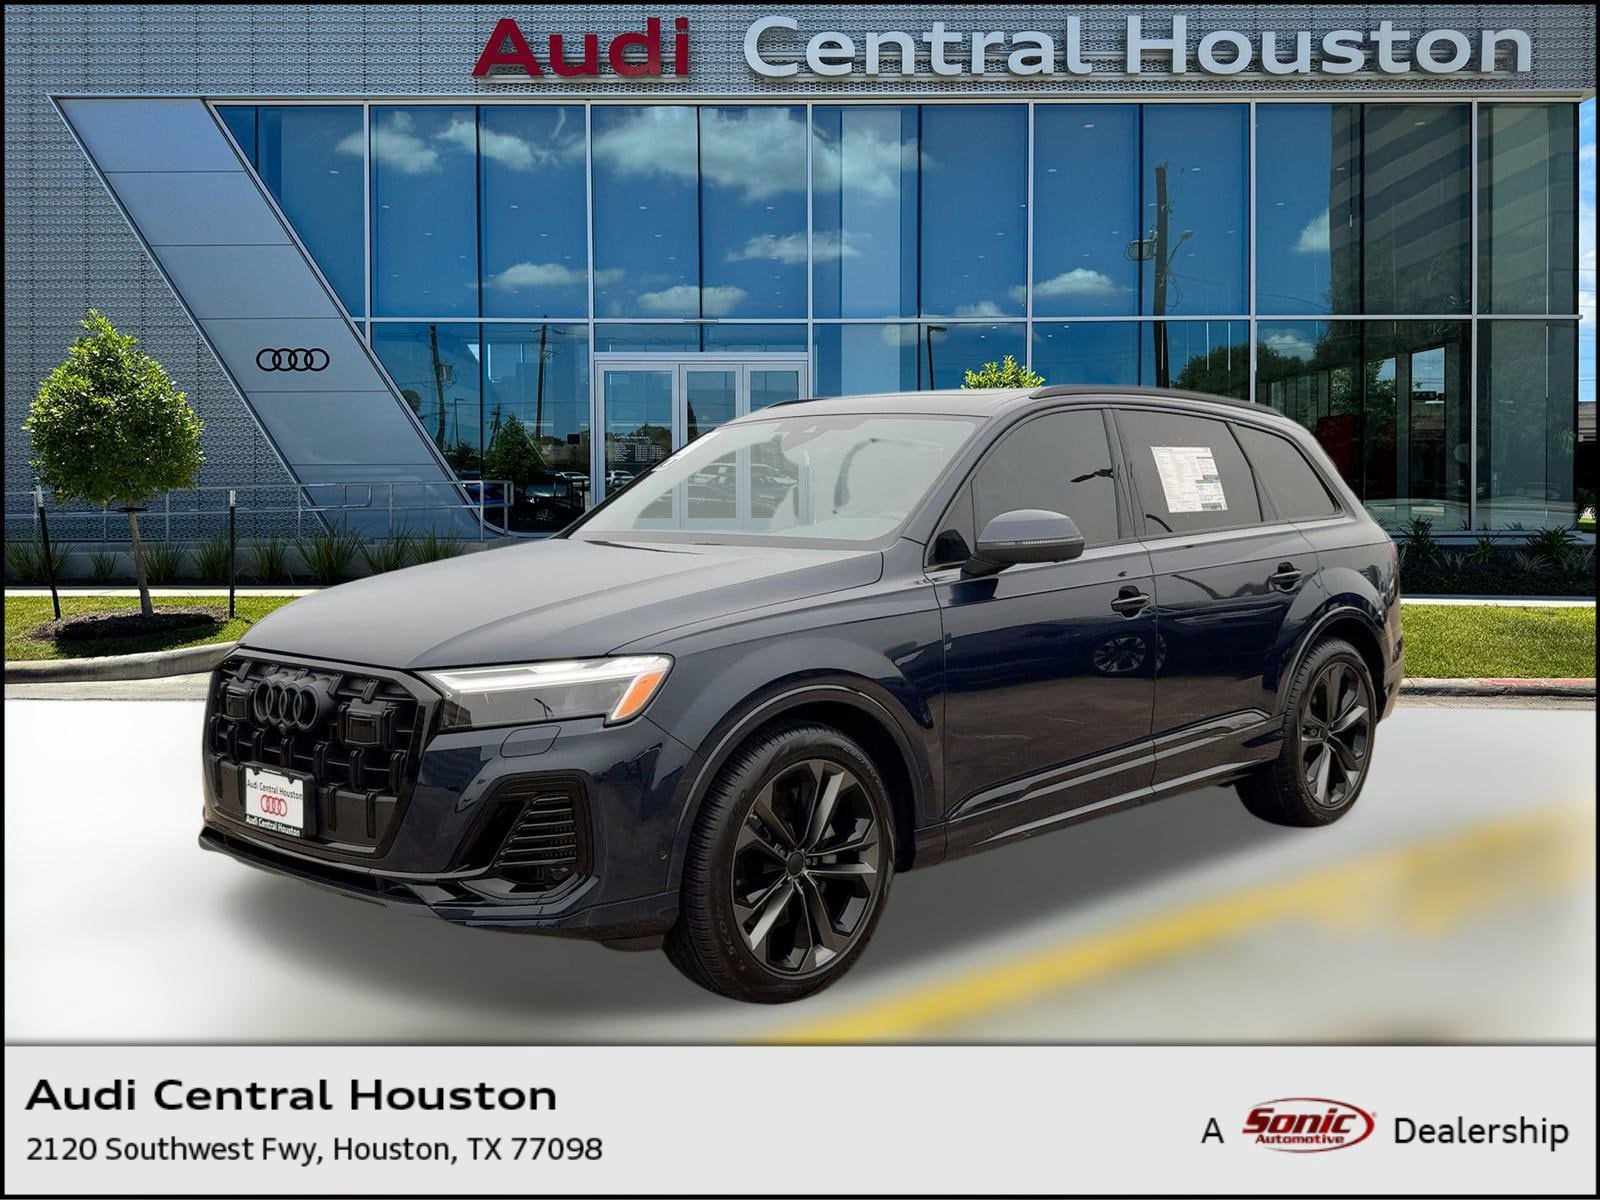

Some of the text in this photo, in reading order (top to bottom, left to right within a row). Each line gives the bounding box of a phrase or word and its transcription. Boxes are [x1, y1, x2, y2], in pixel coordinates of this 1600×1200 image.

[471, 15, 1532, 77] Audi Central Houston
[247, 779, 303, 800] Audi Central Houston
[245, 815, 301, 837] Audi Central Houston
